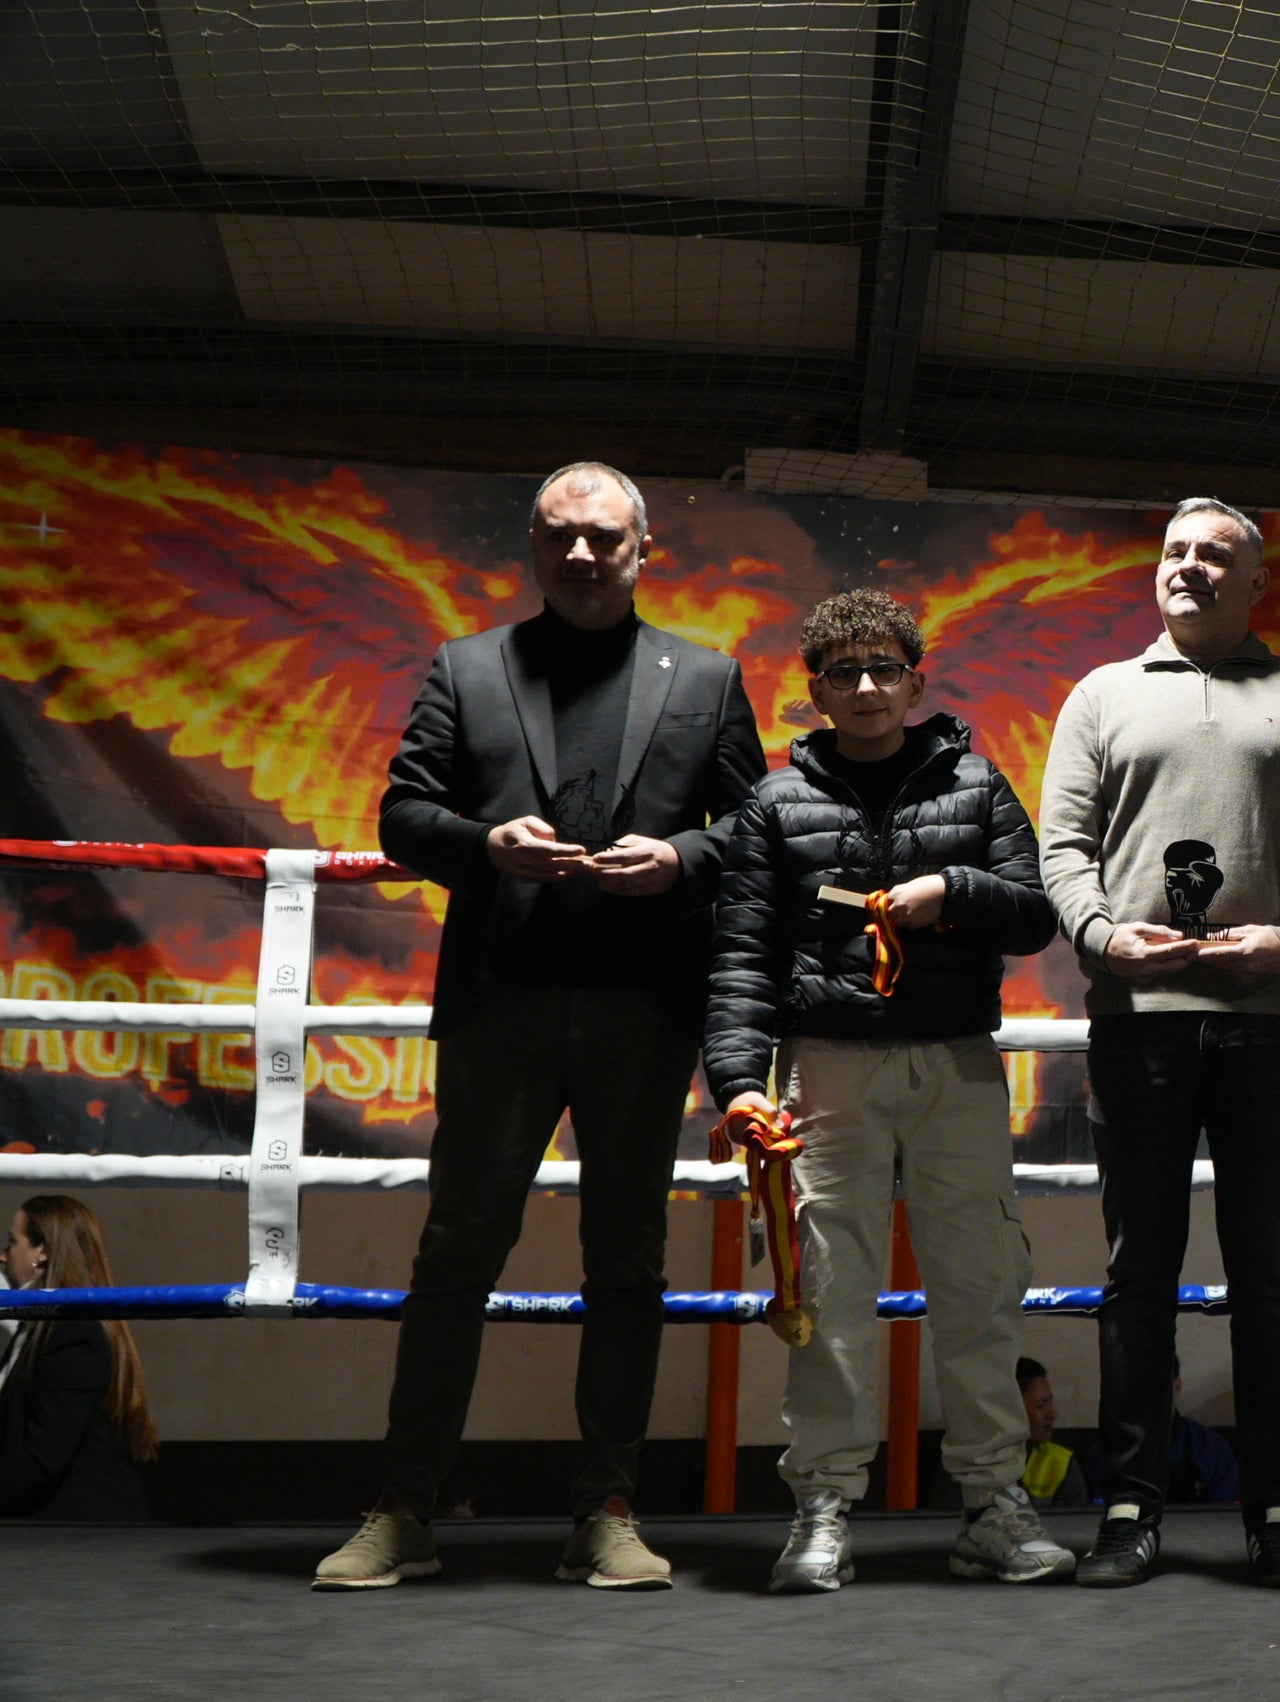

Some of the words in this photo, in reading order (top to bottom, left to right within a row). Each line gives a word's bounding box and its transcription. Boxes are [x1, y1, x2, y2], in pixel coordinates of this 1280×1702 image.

[334, 851, 388, 861] SHAR
[274, 905, 305, 913] SHARK
[269, 987, 300, 995] SHARK
[266, 1076, 297, 1084] SHARK
[260, 1163, 292, 1172] SHARK
[1025, 1287, 1057, 1299] ARK
[512, 1296, 572, 1312] SHARK
